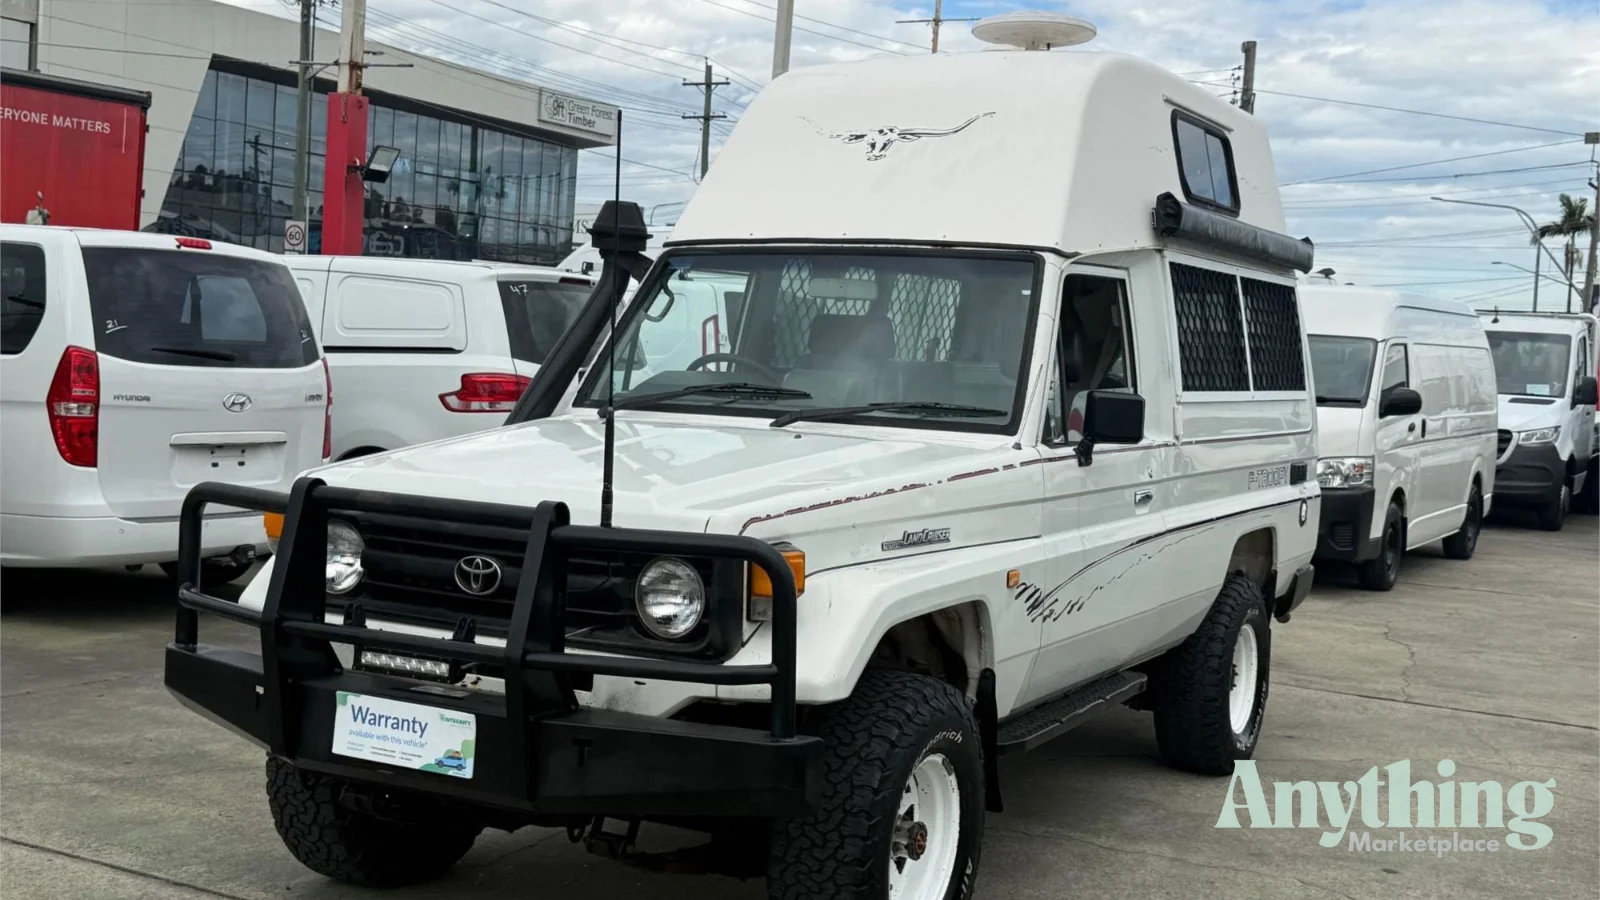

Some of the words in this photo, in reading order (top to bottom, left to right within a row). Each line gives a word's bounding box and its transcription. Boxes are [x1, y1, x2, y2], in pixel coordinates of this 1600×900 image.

[568, 100, 590, 115] Green
[592, 105, 614, 120] Forest
[52, 115, 111, 134] MATTERS
[568, 112, 596, 128] Timber
[288, 231, 301, 241] 60
[509, 284, 529, 296] 47
[113, 394, 151, 402] HYUNDAI
[351, 704, 428, 738] Warranty
[349, 729, 375, 740] available
[376, 734, 390, 742] with
[390, 735, 402, 744] this
